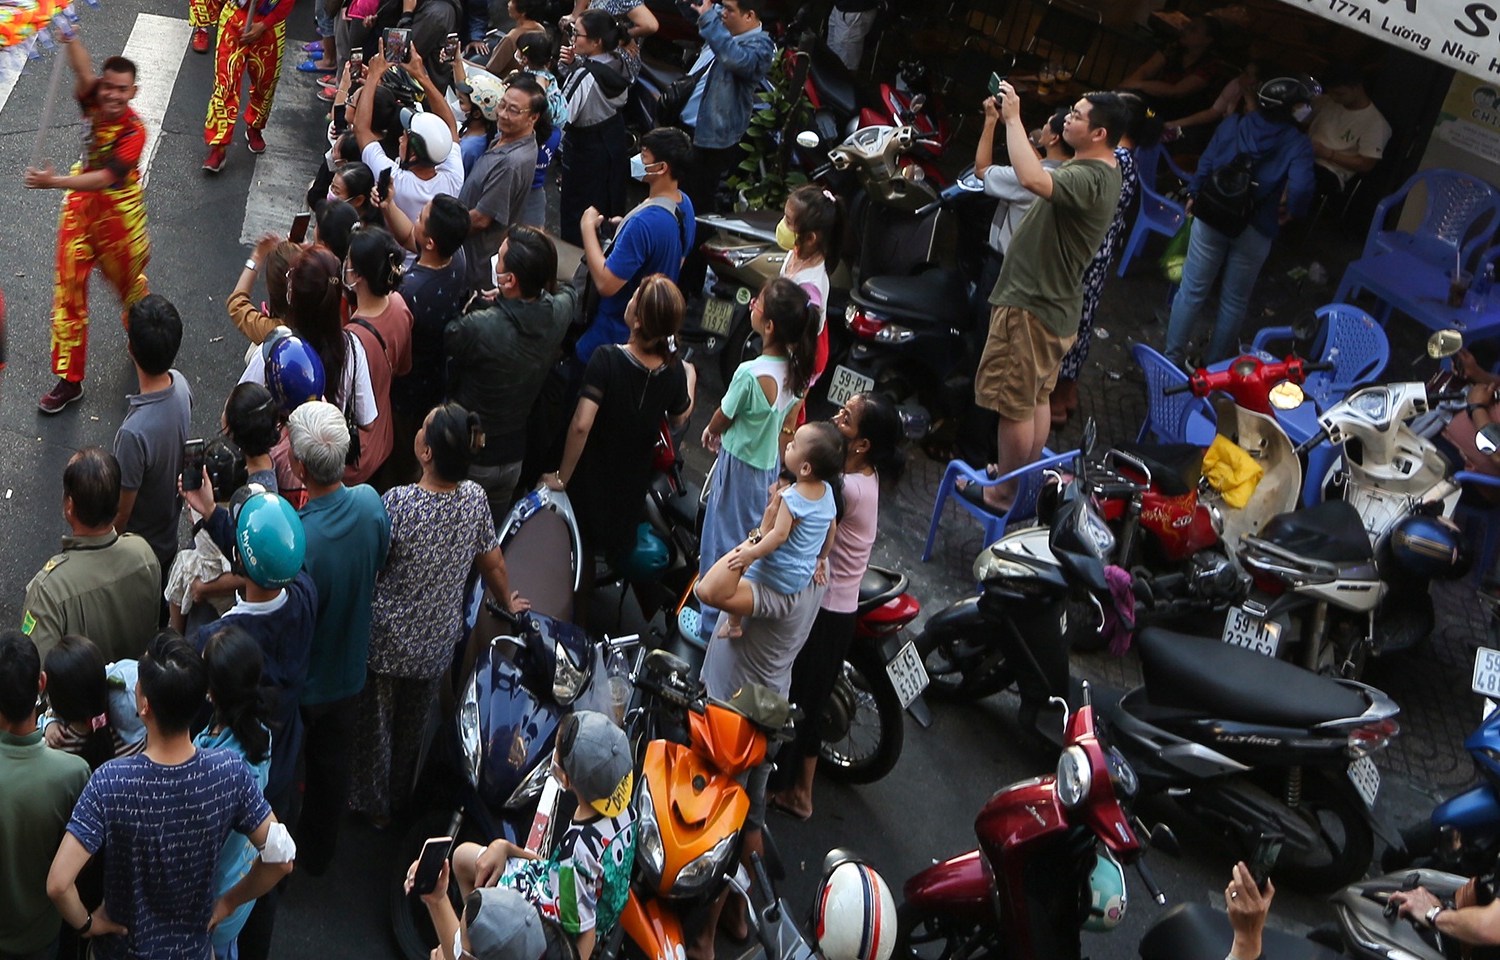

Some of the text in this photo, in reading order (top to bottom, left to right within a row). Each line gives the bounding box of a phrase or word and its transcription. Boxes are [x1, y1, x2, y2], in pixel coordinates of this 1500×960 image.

[1453, 2, 1500, 41] S
[1381, 16, 1432, 51] Lương
[1441, 40, 1480, 66] Nhữ
[1471, 108, 1500, 127] CHI
[900, 667, 923, 701] 5387
